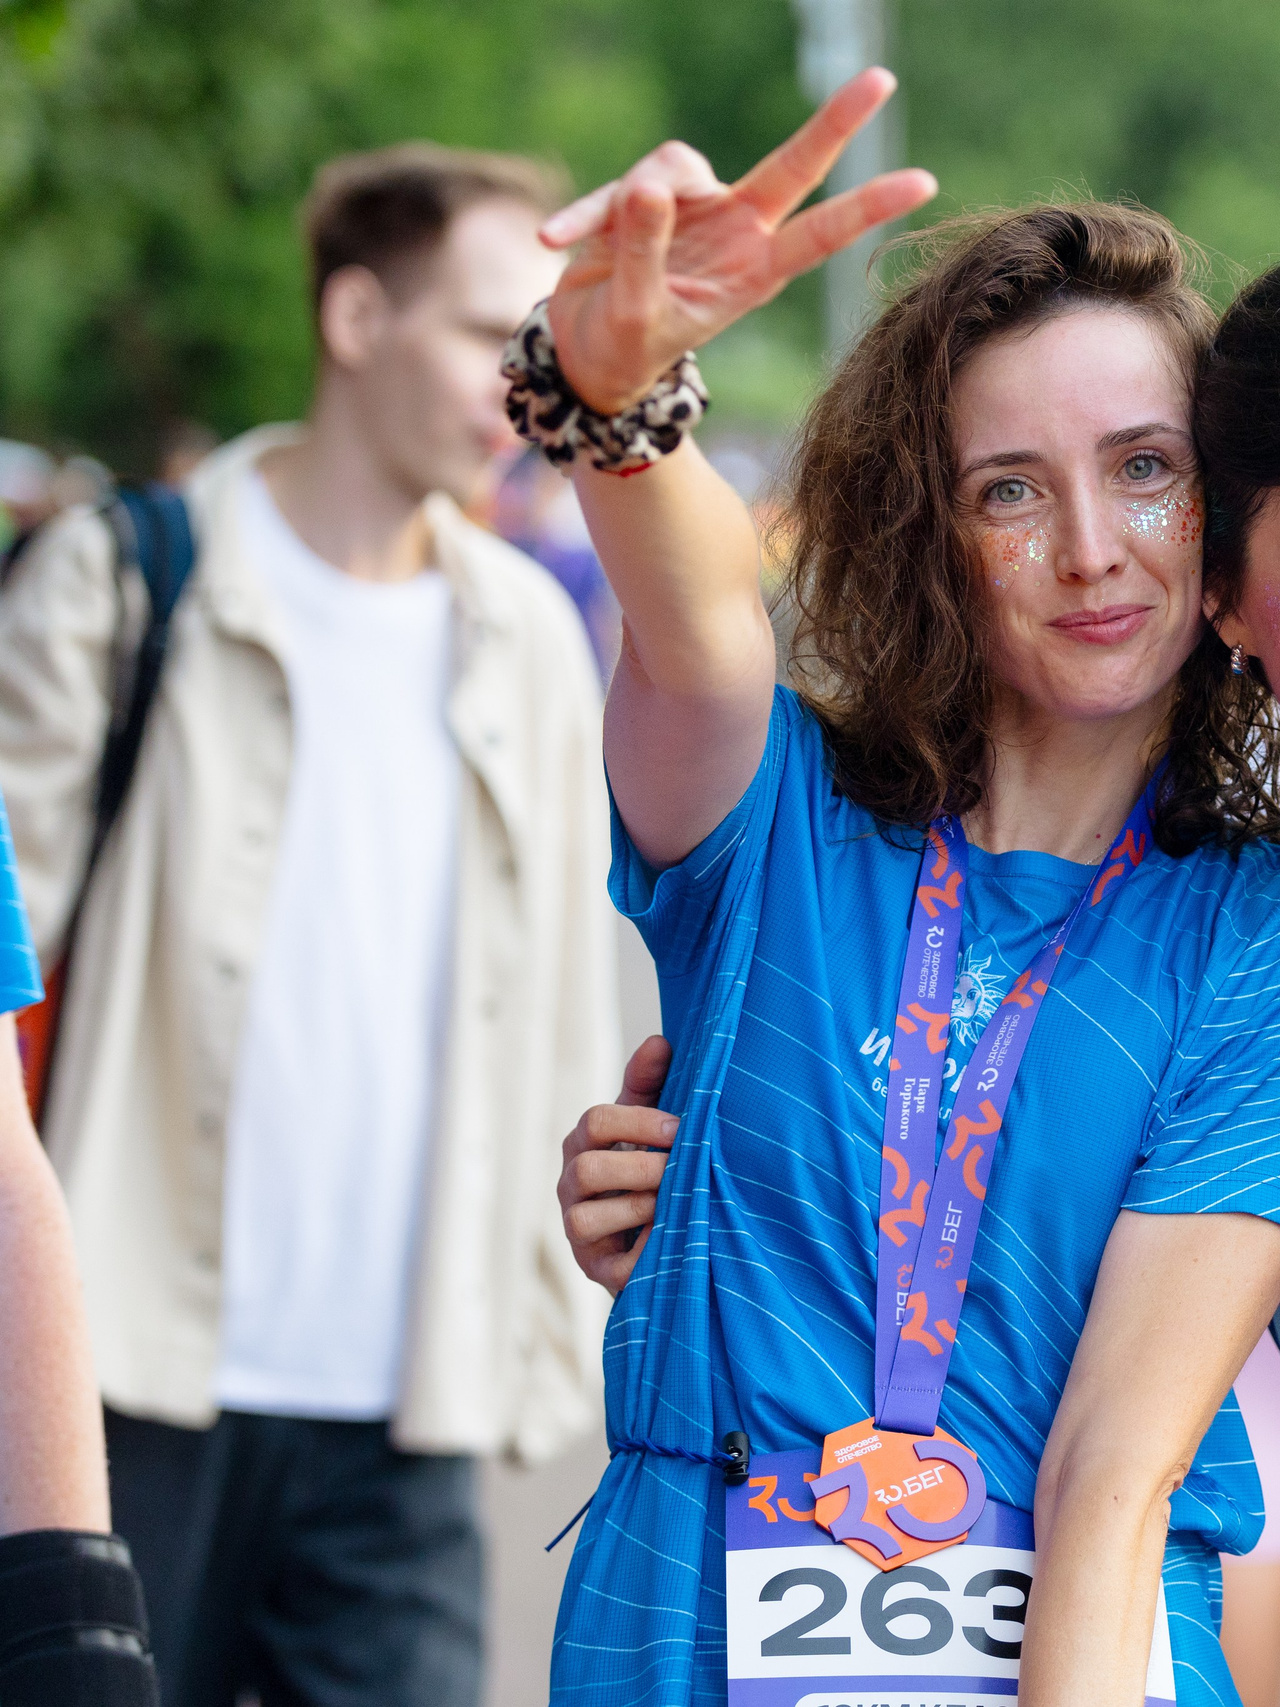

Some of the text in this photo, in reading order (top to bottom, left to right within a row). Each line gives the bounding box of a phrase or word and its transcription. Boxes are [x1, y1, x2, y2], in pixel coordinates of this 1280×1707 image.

[917, 947, 932, 998] ОТЕЧЕСТВО
[927, 951, 941, 999] ЗДОРОВОЕ
[985, 1014, 1012, 1065] ЗДОРОВОЕ
[995, 1014, 1021, 1067] ОТЕЧЕСТВО
[899, 1078, 917, 1140] Горького
[913, 1078, 931, 1114] Парк
[834, 1434, 880, 1457] ЗДОРОВОЕ
[837, 1442, 882, 1464] ОТЕЧЕСТВО
